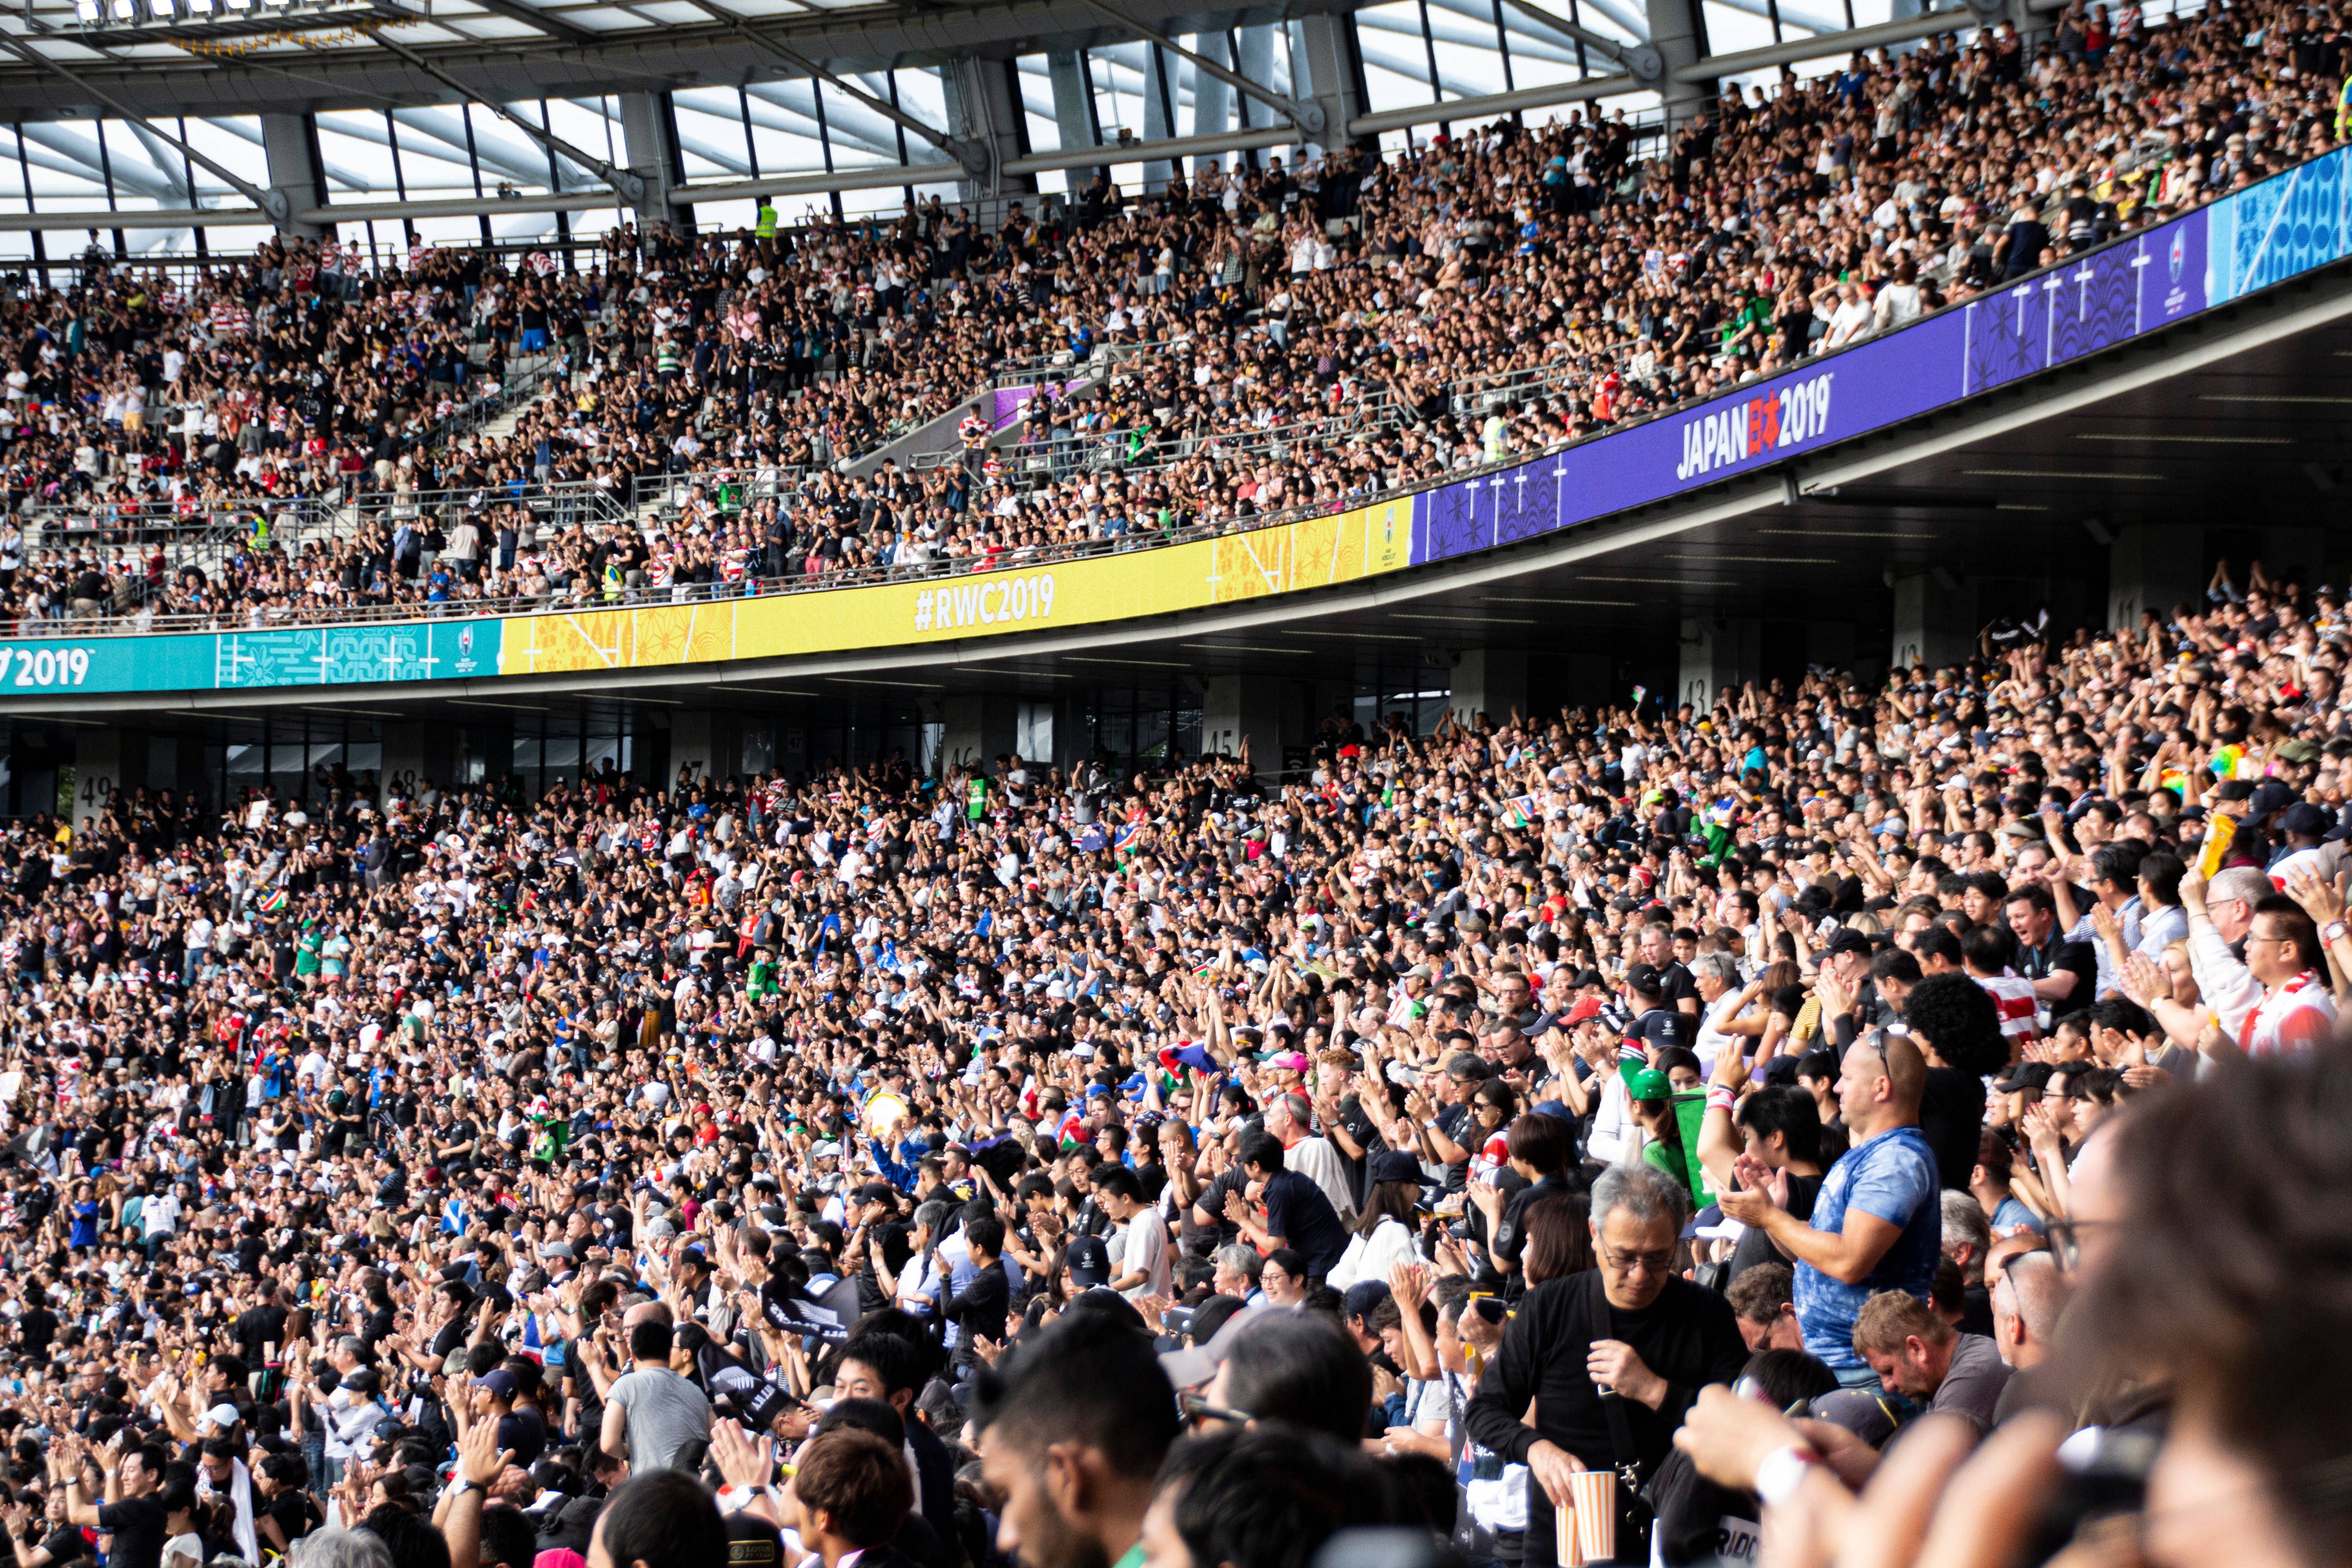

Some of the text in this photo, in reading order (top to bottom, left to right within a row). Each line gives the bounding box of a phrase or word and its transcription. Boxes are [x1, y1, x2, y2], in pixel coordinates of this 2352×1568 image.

[1676, 402, 1749, 481] JAPAN
[1778, 373, 1830, 448] 2019
[915, 573, 1054, 632] #RWC2019
[15, 647, 89, 686] 2019
[80, 776, 112, 808] 49
